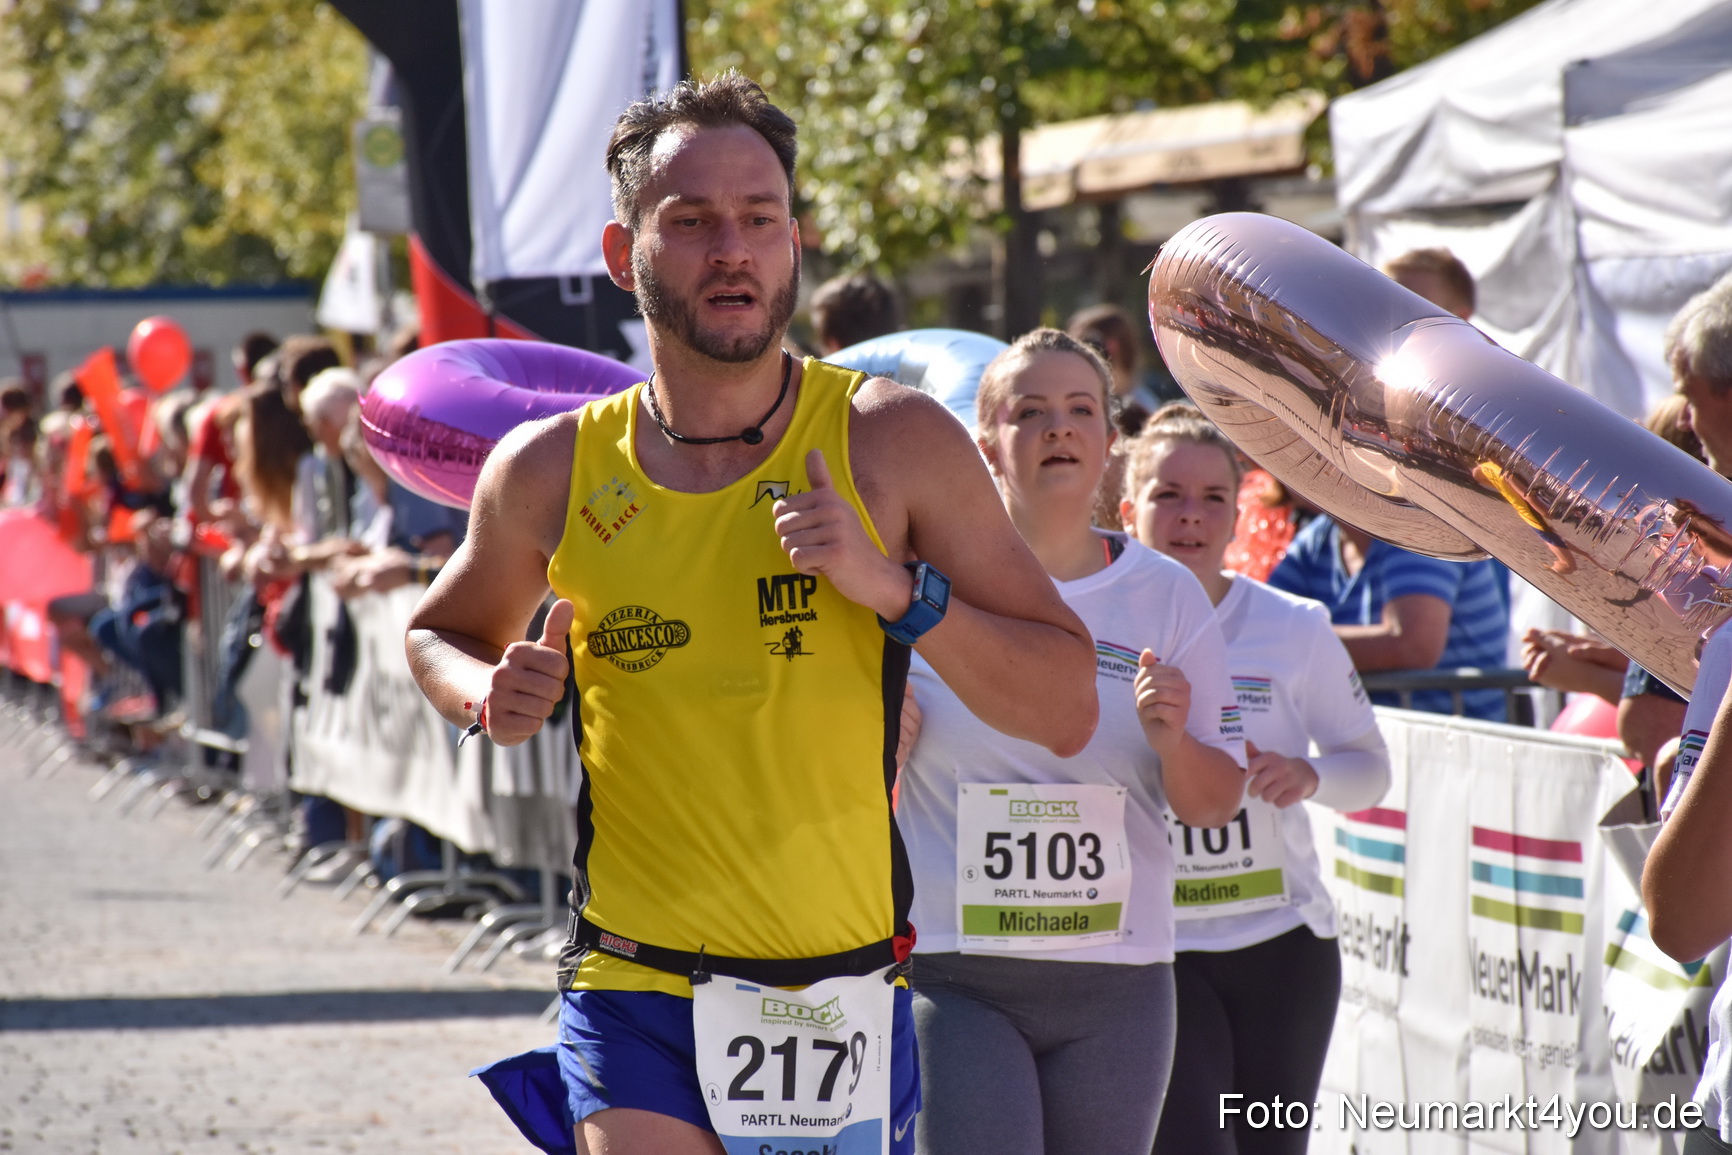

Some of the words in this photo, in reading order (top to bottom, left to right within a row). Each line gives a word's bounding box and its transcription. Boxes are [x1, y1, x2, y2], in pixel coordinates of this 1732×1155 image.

[579, 505, 612, 544] WERNER
[612, 503, 640, 532] BECK
[757, 573, 817, 614] MTP
[599, 608, 659, 631] PIZZERIA
[760, 608, 818, 628] Hersbruck
[594, 625, 675, 655] FRANCESCO
[609, 650, 664, 671] HERSBRUCK
[1009, 800, 1080, 817] BOCK
[1164, 807, 1251, 856] 101
[984, 832, 1105, 881] 5103
[1192, 861, 1239, 873] Neumarkt
[994, 889, 1030, 899] PARTL
[1033, 889, 1082, 899] Neumarkt
[1175, 882, 1240, 903] Nadine
[999, 911, 1089, 932] Michaela
[599, 932, 638, 953] HIGH5
[761, 995, 844, 1025] BOCK
[760, 1016, 792, 1027] inspired
[794, 1020, 804, 1028] by
[806, 1022, 828, 1032] smart
[726, 1030, 867, 1101] 2179
[741, 1114, 786, 1126] PARTL
